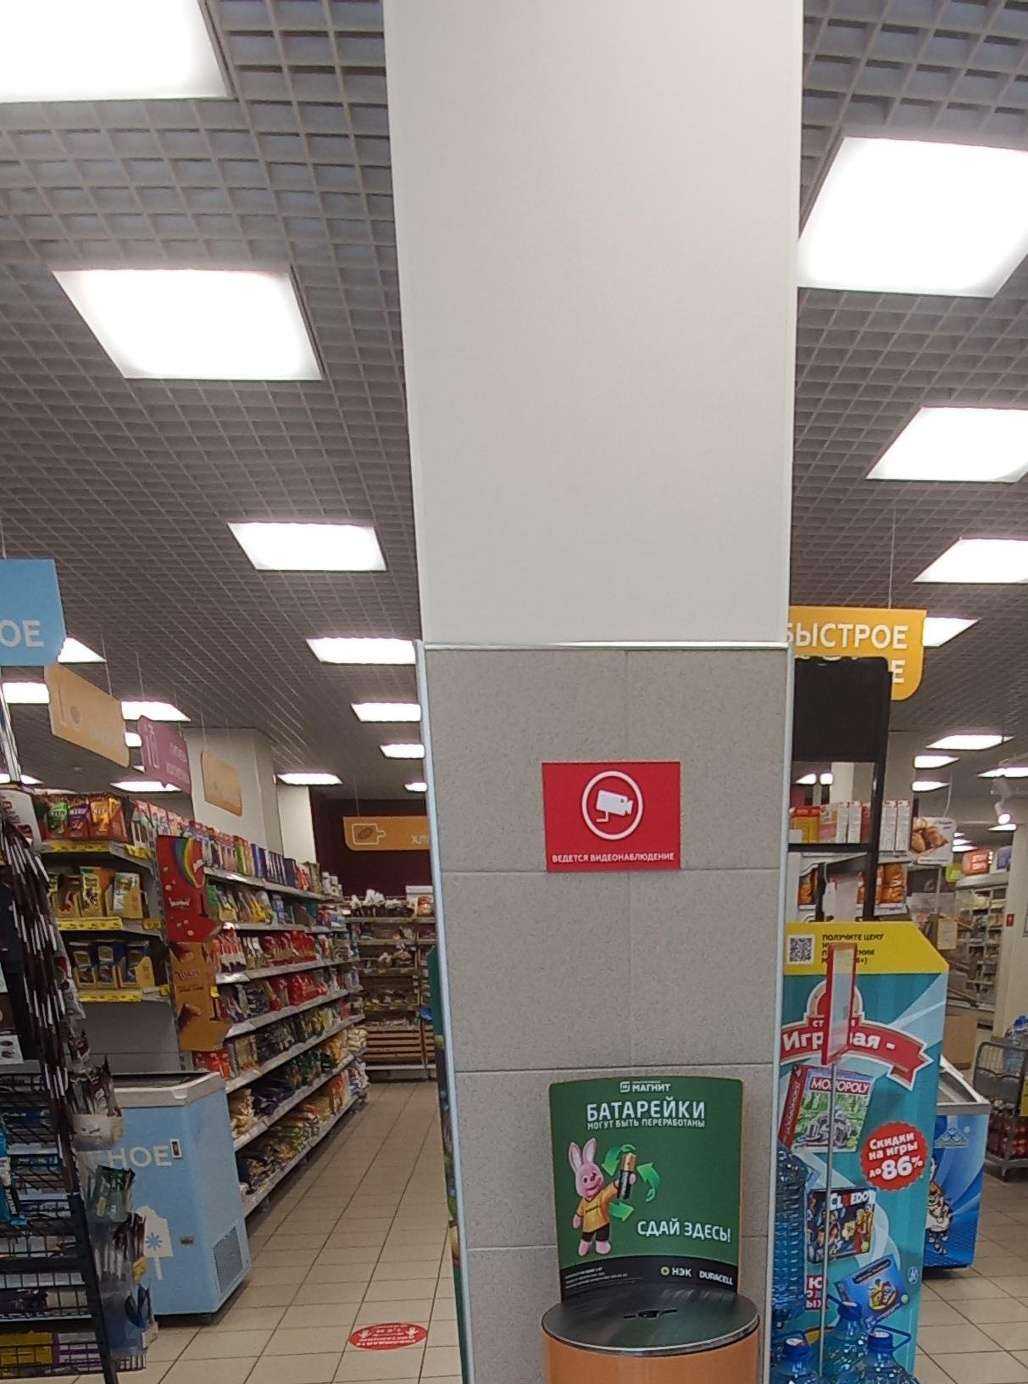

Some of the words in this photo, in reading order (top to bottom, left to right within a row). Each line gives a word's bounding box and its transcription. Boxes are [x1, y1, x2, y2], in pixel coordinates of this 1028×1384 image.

[552, 853, 589, 863] ВЕДЕТСЯ
[590, 852, 675, 863] ВИДЕОНАБЛЮДЕНИЕ
[782, 1031, 881, 1051] Играя
[632, 1083, 671, 1093] МАГНИТ
[811, 1077, 870, 1094] MOOPOLY
[586, 1096, 705, 1122] БАТАРЕЙКИ
[587, 1120, 614, 1131] МОГУТ
[615, 1119, 640, 1128] БЫТЬ
[641, 1118, 705, 1129] ПЕРЕРАБОТАНЫ
[869, 1132, 915, 1151] Скидки
[868, 1149, 884, 1161] на
[886, 1141, 919, 1156] игры
[881, 1155, 924, 1181] 86%
[637, 1218, 681, 1238] СДАЙ
[684, 1222, 731, 1243] ЗДЕСЬ!
[671, 1267, 692, 1278] НЭК
[699, 1270, 734, 1286] DURACELL
